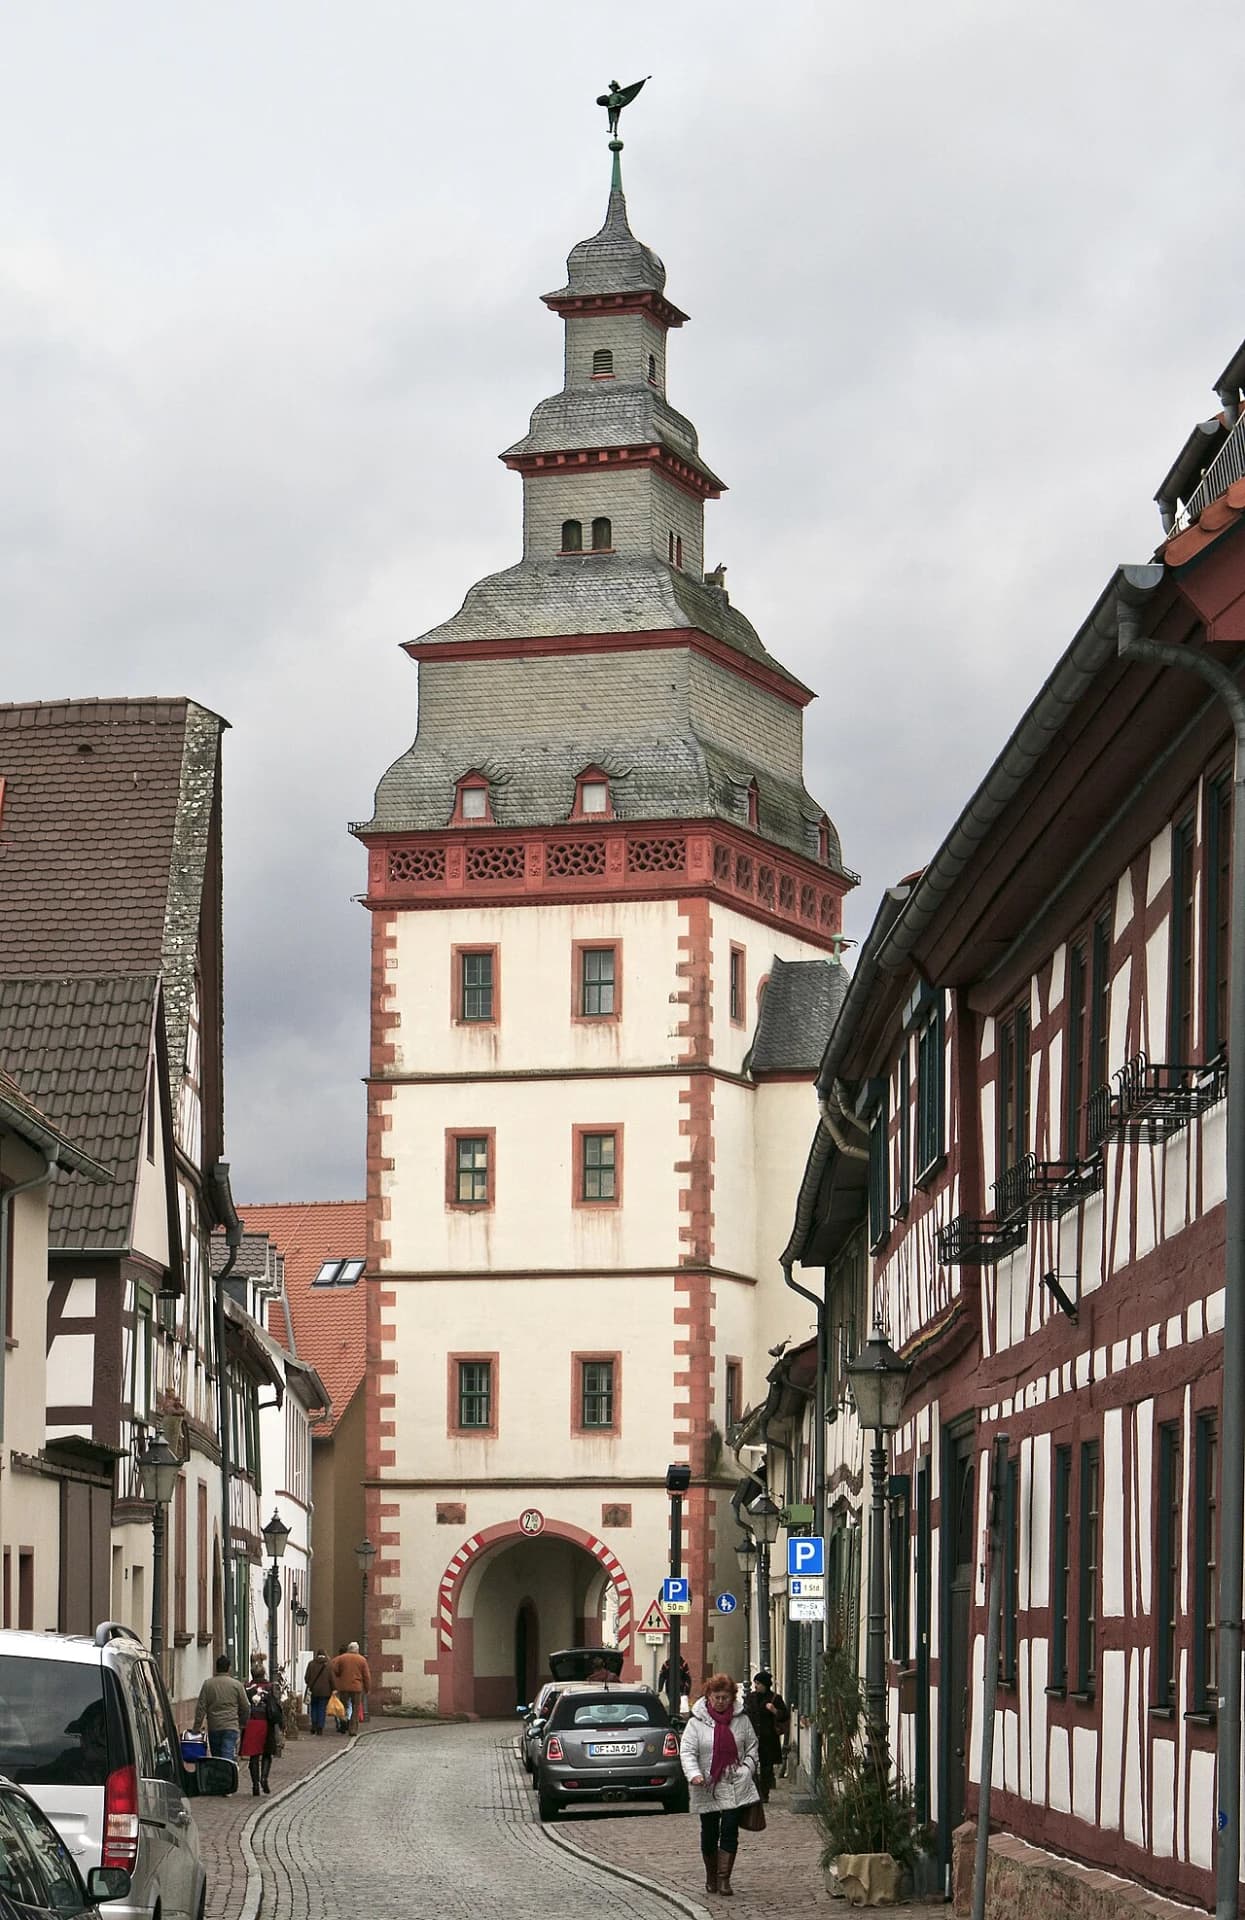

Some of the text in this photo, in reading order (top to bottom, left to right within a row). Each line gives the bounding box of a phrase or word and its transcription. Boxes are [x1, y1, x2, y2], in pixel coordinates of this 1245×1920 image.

[796, 1542, 816, 1570] P
[668, 1581, 682, 1600] P
[667, 1603, 677, 1611] 50
